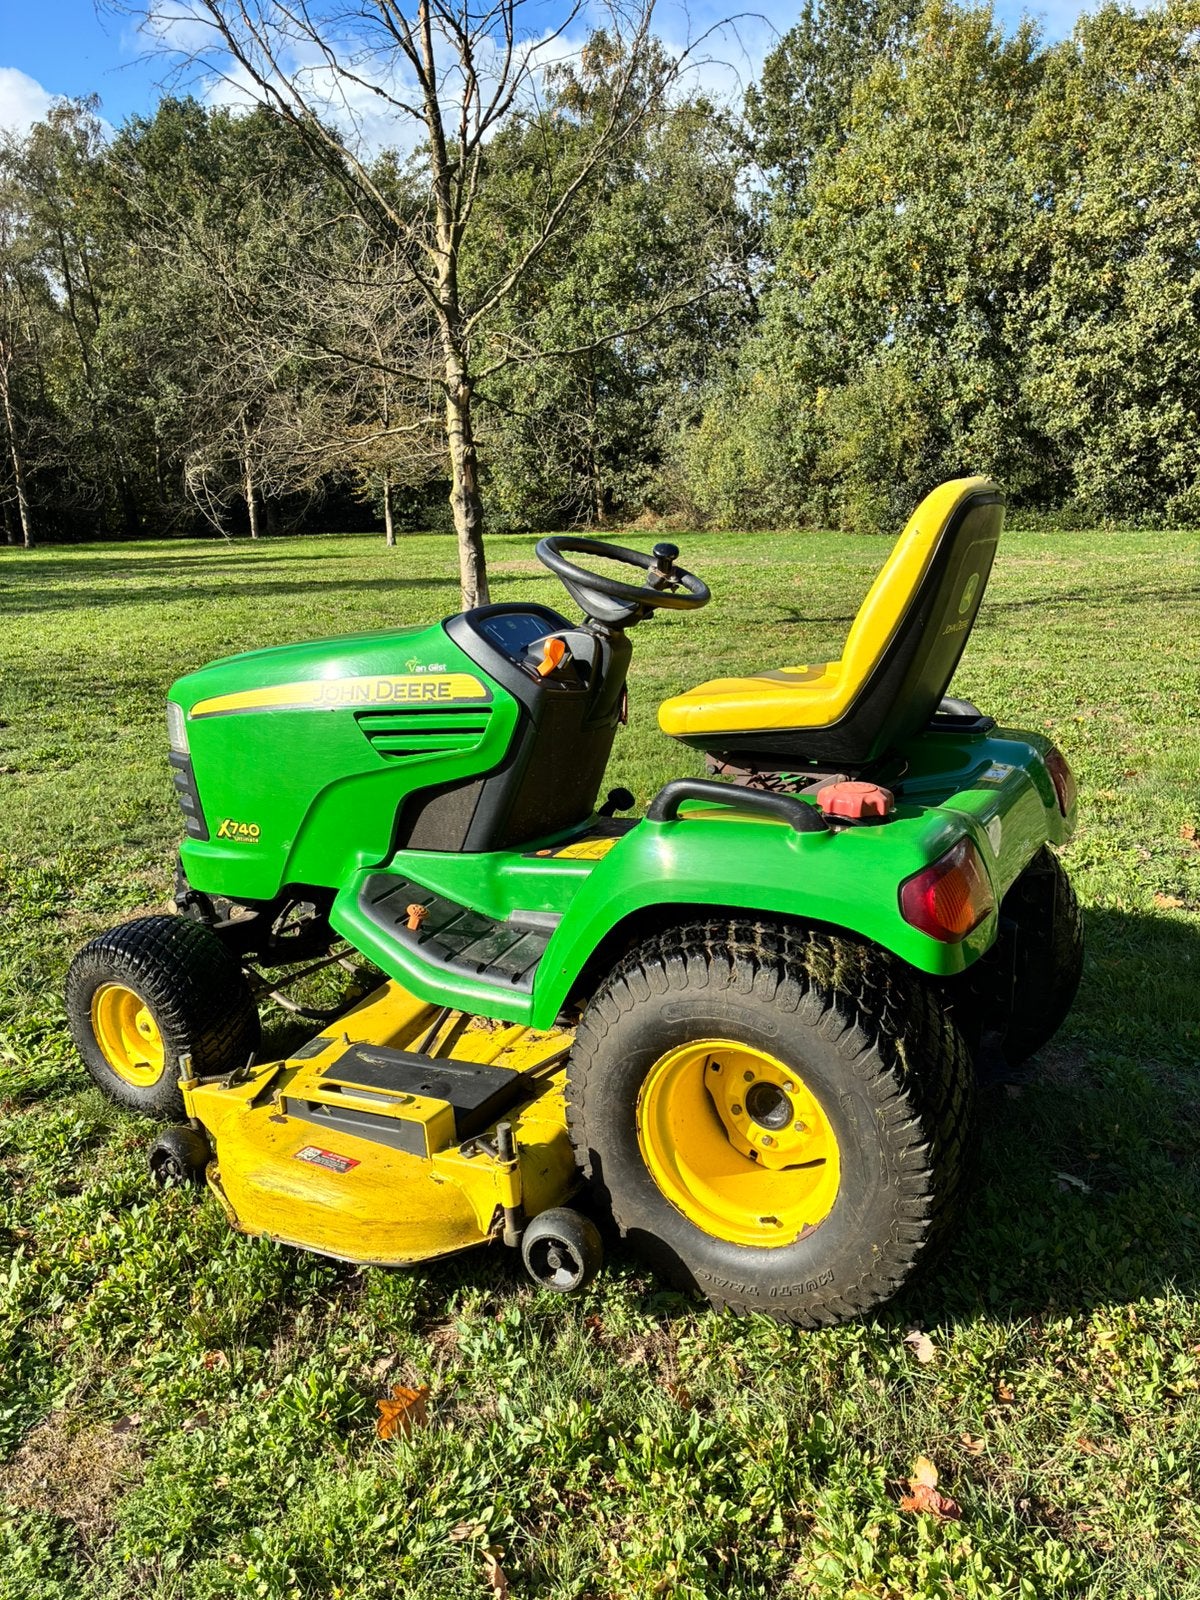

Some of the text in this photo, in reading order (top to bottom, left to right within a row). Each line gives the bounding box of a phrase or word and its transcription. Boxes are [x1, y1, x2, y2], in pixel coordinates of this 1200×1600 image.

[406, 658, 427, 673] Van
[314, 680, 452, 702] JOHN DEERE
[217, 819, 260, 838] X740
[695, 1268, 835, 1297] MULTI TRAC
